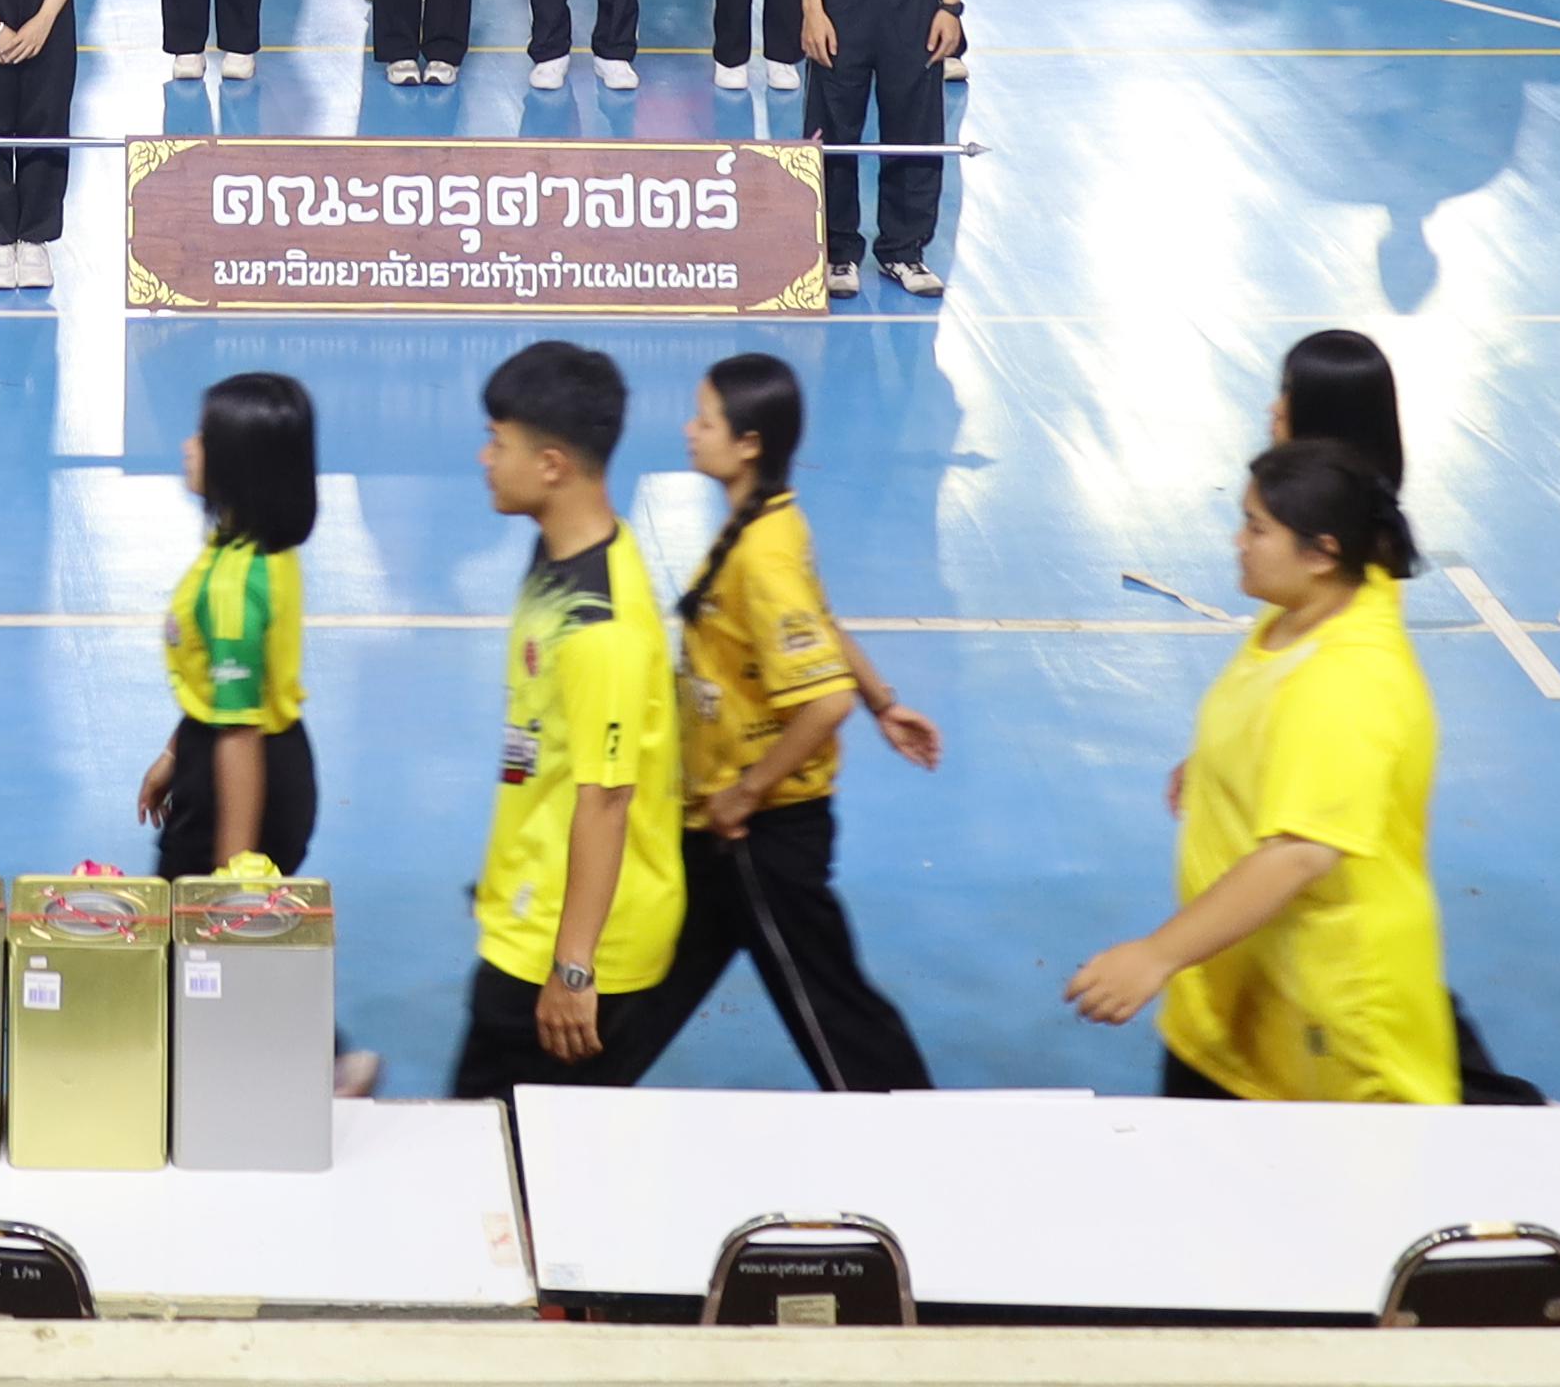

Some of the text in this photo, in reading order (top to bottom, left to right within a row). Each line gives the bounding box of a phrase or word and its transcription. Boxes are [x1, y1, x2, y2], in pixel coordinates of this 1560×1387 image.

[212, 151, 739, 255] คณะครุศาสตร์
[214, 249, 739, 297] มหาวิทยาลัยราชภัฏกำแพงเพชร
